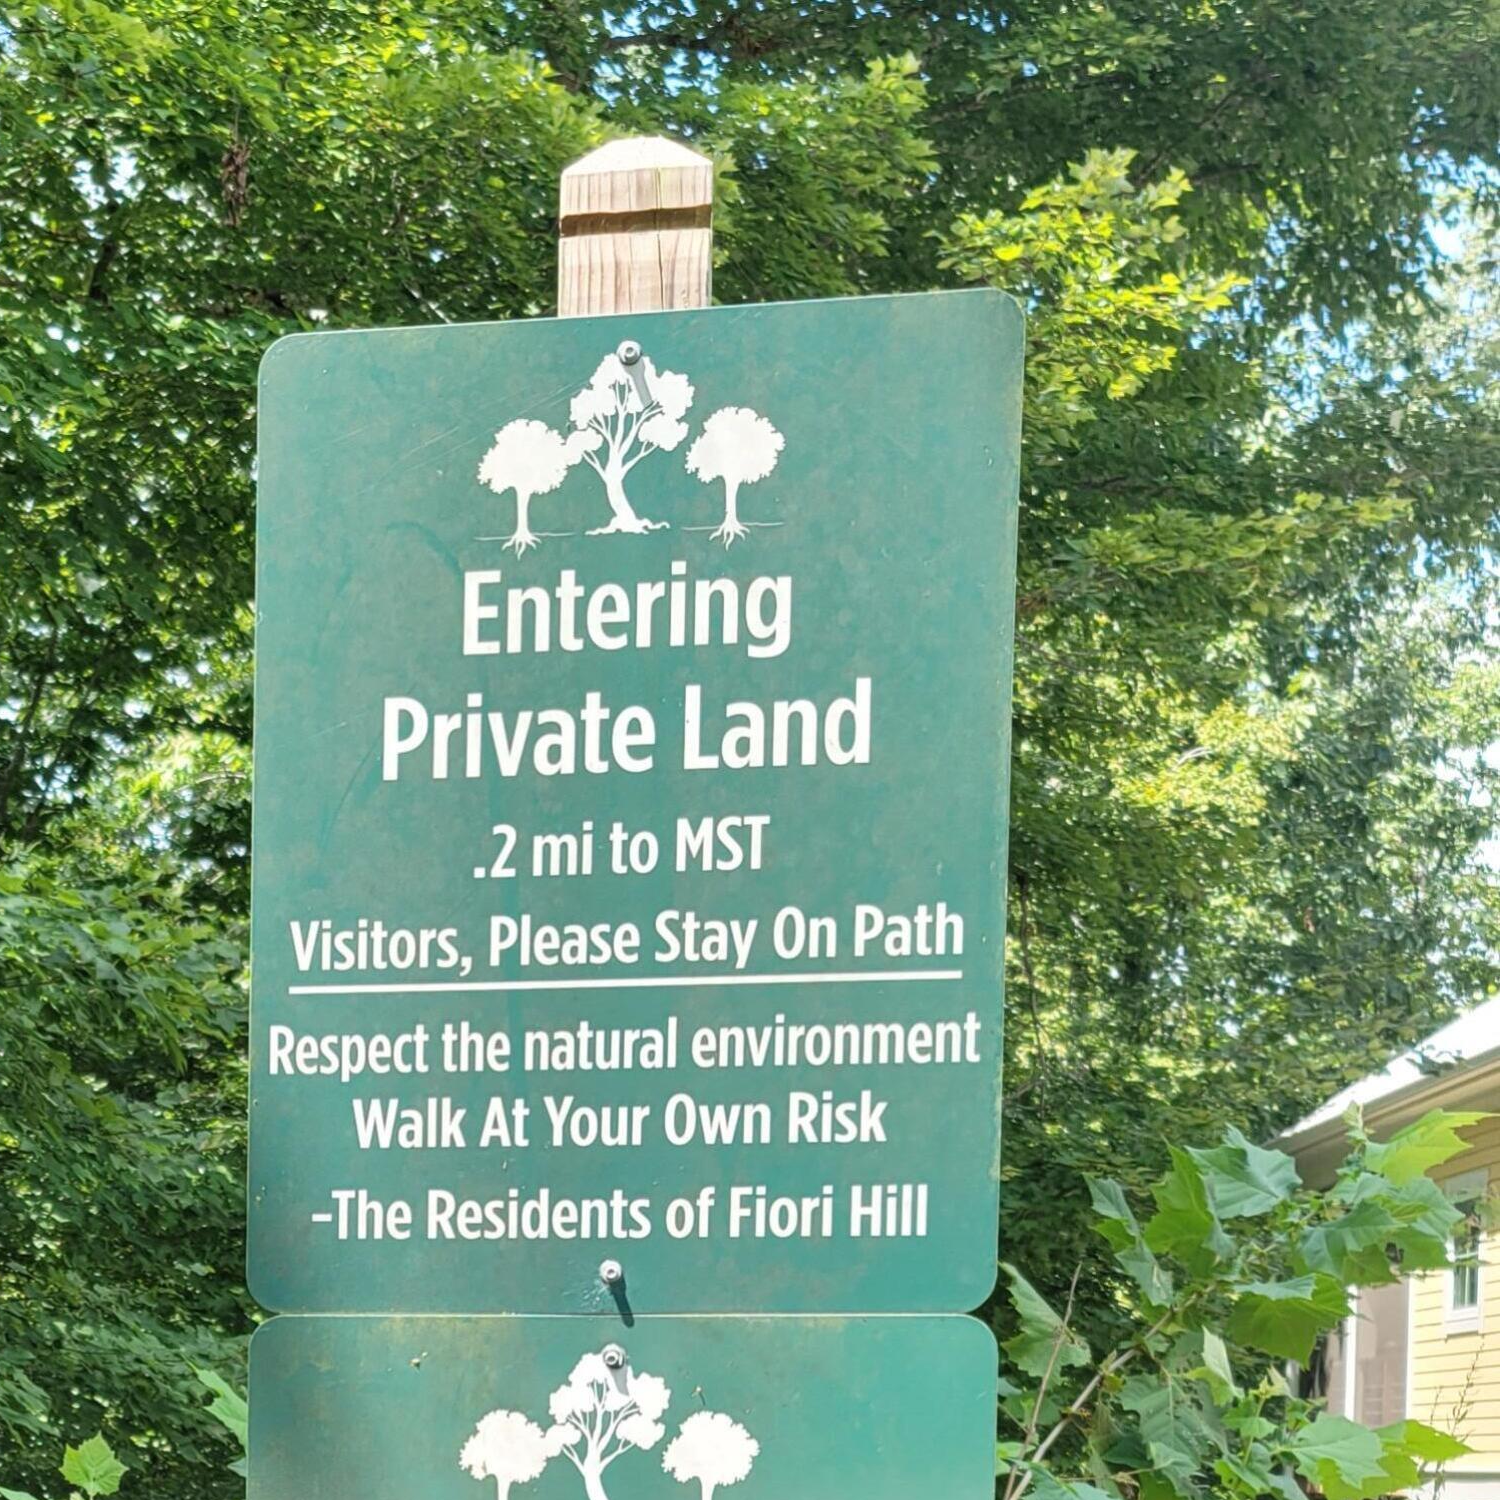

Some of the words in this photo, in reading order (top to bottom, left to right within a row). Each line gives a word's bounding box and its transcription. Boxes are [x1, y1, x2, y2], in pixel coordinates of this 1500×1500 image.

[462, 560, 792, 659] Entering
[382, 691, 656, 781] Private
[683, 676, 872, 770] Land
[473, 823, 517, 879] .2
[532, 820, 593, 877] mi
[609, 822, 659, 874] to
[675, 815, 771, 872] MST
[289, 918, 473, 977] Visitors,
[489, 914, 641, 967] Please
[654, 909, 758, 970] Stay
[773, 906, 837, 959] On
[854, 902, 964, 957] Path
[269, 1024, 430, 1083] Respect
[441, 1021, 511, 1073] the
[524, 1016, 678, 1071] natural
[691, 1011, 982, 1068] environment
[352, 1096, 467, 1149] Walk
[479, 1096, 530, 1147] At
[543, 1095, 651, 1147] Your
[664, 1093, 771, 1146] Own
[788, 1089, 888, 1143] Risk
[427, 1187, 652, 1240] Residents
[665, 1186, 716, 1239] of
[729, 1184, 833, 1238] Fiori
[850, 1183, 928, 1237] Hill
